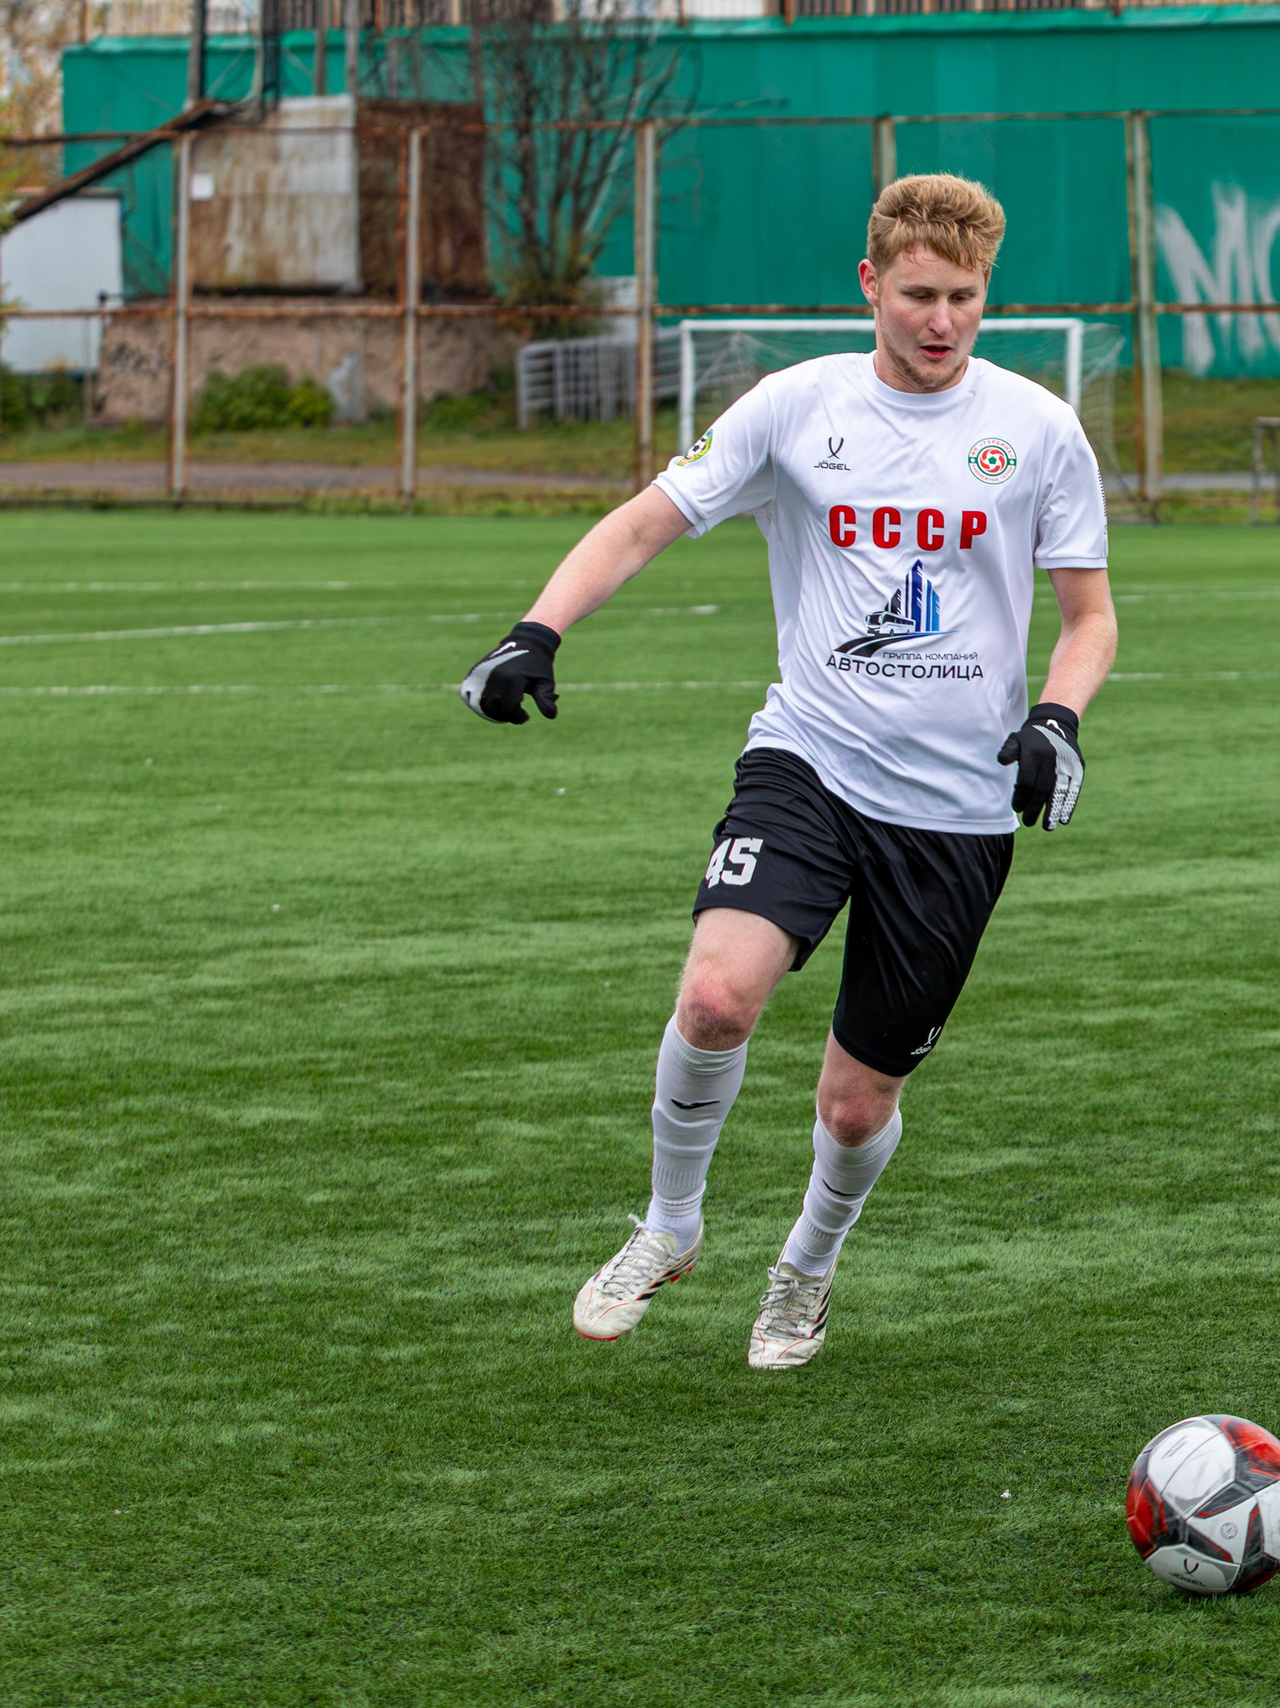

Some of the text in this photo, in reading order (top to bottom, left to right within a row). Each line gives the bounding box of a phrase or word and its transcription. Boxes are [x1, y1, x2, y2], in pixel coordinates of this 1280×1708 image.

[813, 459, 851, 471] JÖGEL
[828, 504, 988, 552] СССР
[825, 654, 984, 681] АВТОСТОЛИЦА
[882, 651, 978, 662] ГРУППА КОМПАНИЙ
[704, 837, 764, 889] 45
